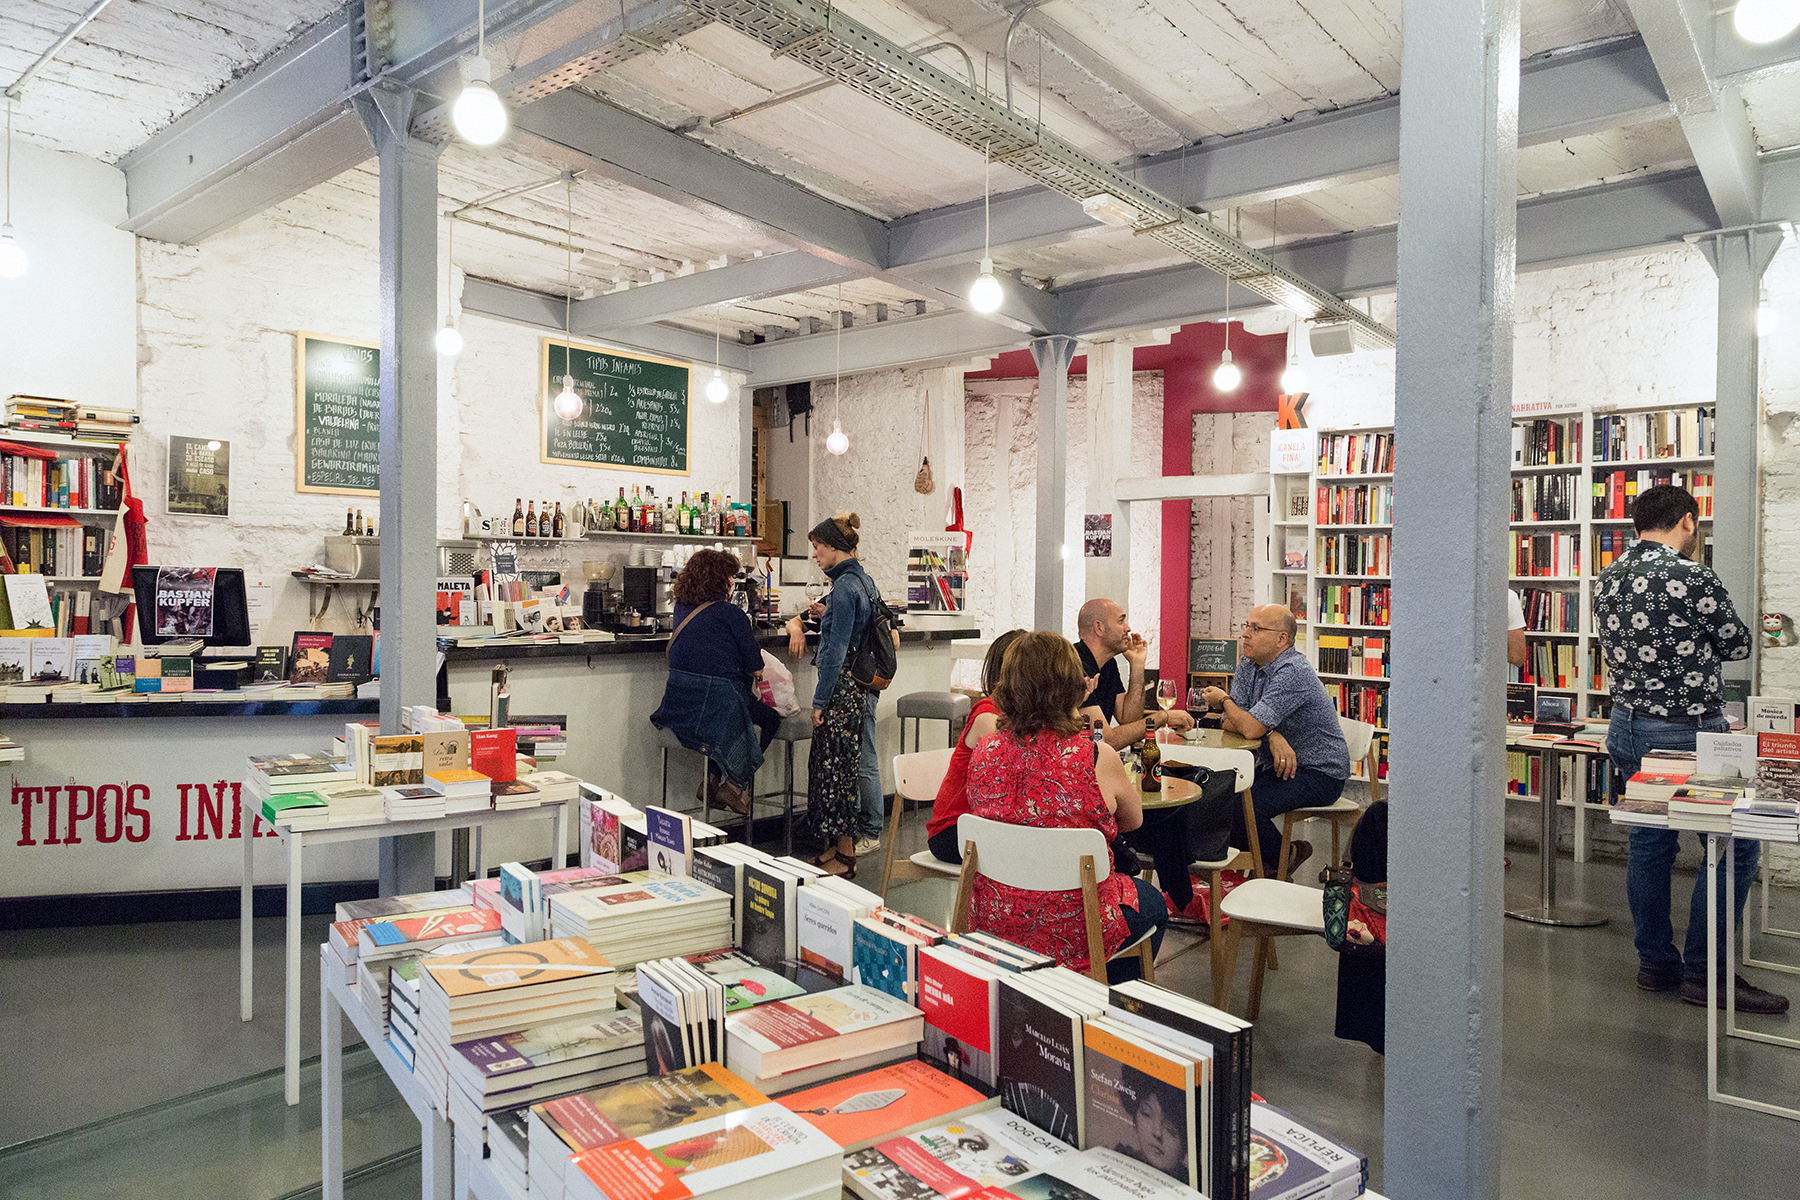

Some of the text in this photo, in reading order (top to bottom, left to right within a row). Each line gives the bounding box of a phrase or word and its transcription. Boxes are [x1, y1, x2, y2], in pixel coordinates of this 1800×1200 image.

[1511, 402, 1552, 412] NARRATIVA
[437, 582, 471, 591] MALETA
[158, 590, 211, 599] BASTIAN
[159, 598, 210, 607] KUPFER
[1771, 741, 1797, 750] triunfo
[11, 777, 151, 847] TIPOS
[804, 913, 838, 936] Seres queridos
[1090, 1068, 1137, 1101] Stefan Zweig
[1006, 1120, 1032, 1138] DOG
